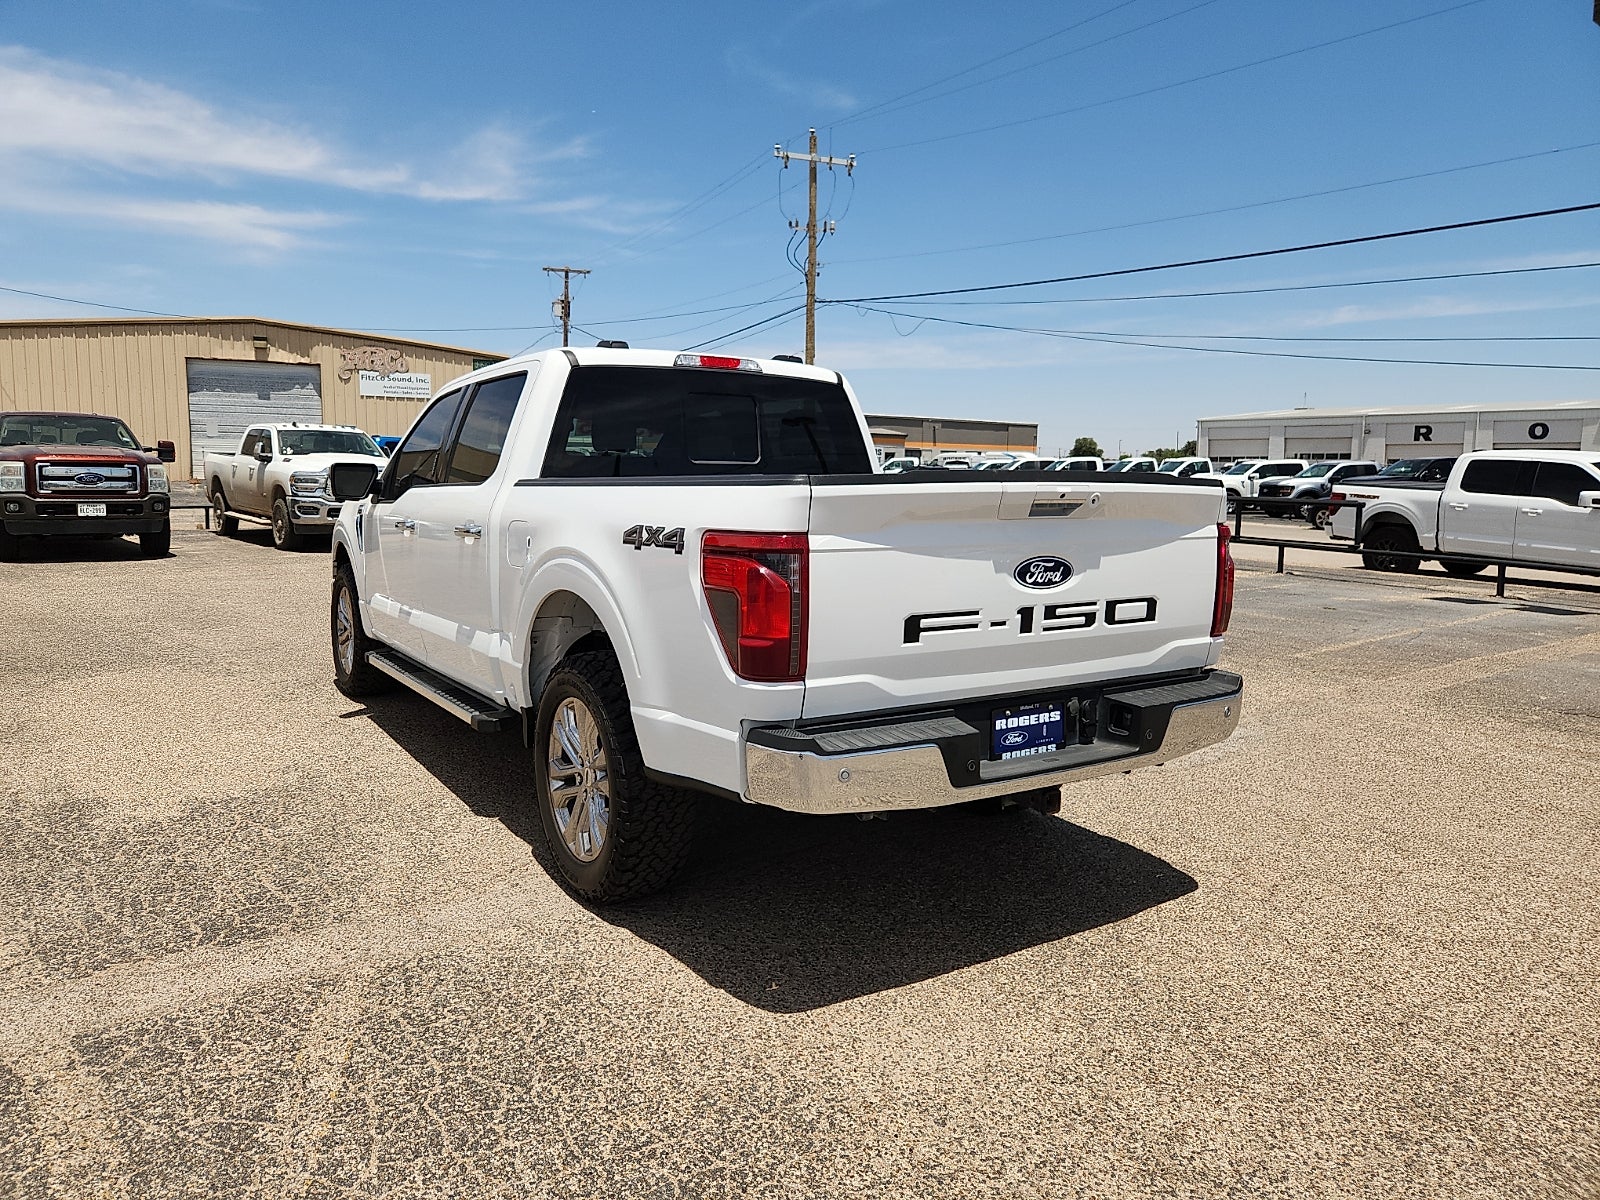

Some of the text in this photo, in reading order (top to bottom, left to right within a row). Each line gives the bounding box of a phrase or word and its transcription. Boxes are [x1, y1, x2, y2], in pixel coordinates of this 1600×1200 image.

[361, 373, 430, 385] FitzCo Sound, Inc.
[1413, 425, 1433, 441] R
[1528, 422, 1549, 440] O
[1025, 561, 1064, 583] Ford
[903, 595, 1159, 646] F-150
[995, 710, 1061, 730] ROGERS
[1005, 732, 1024, 744] Ford
[1002, 744, 1057, 760] ROGERS
